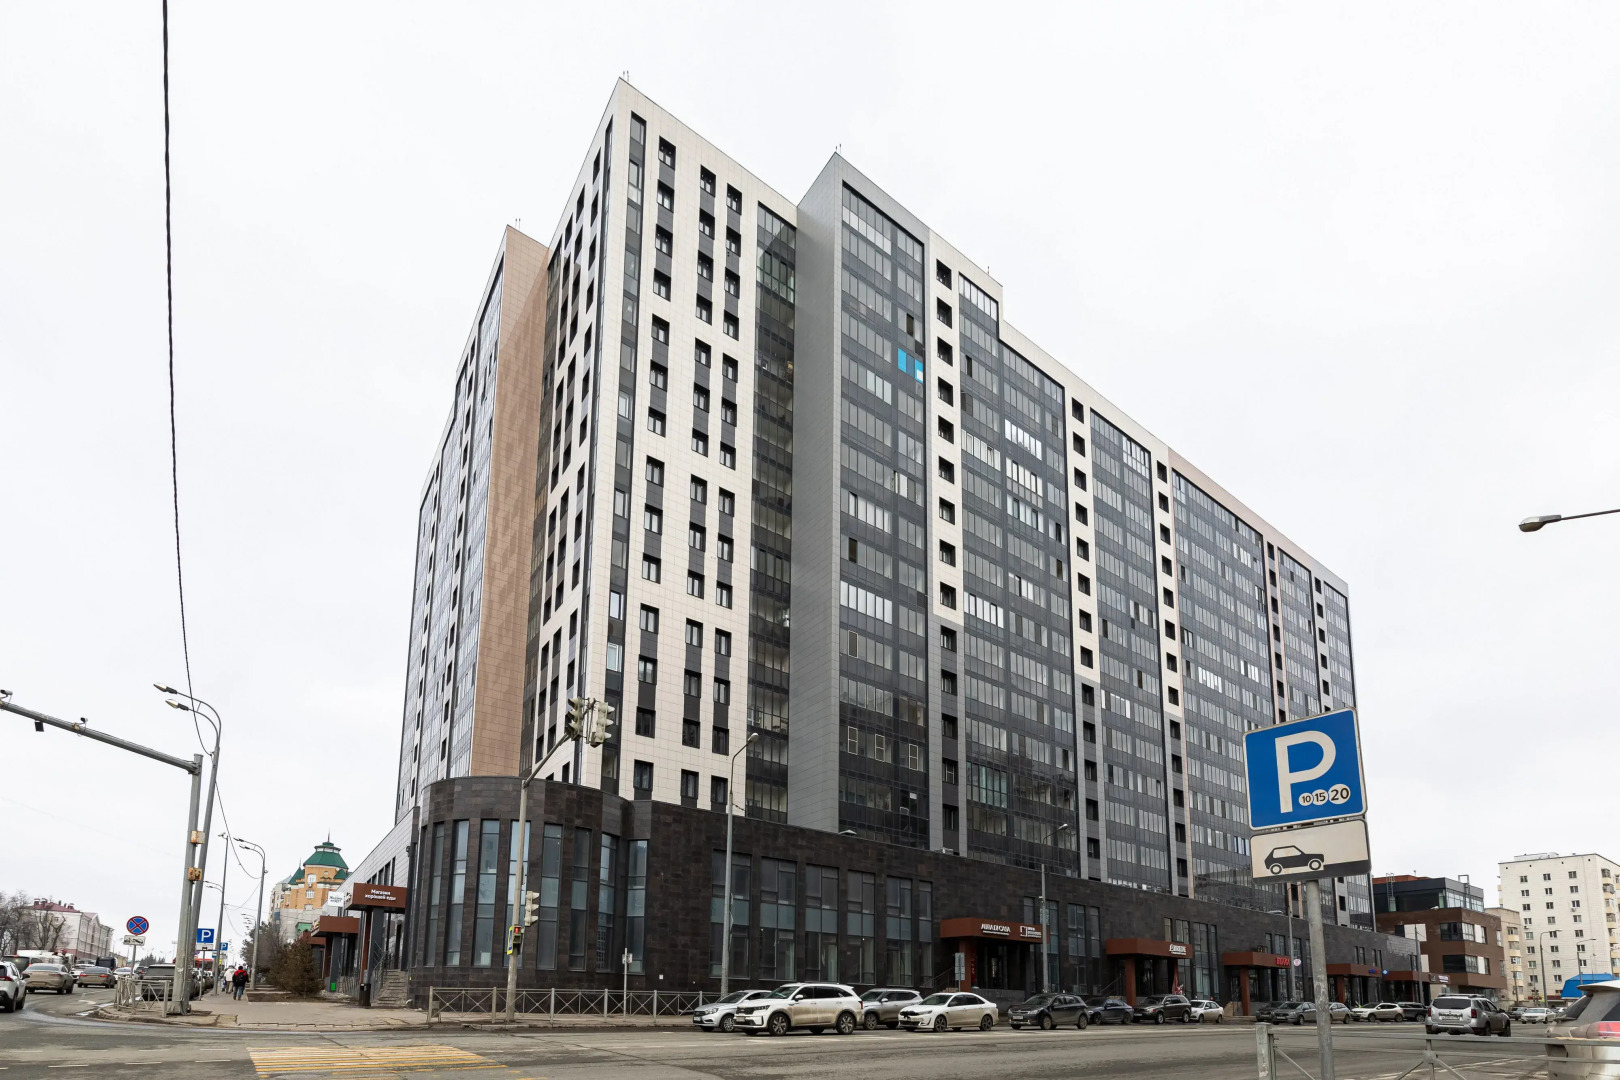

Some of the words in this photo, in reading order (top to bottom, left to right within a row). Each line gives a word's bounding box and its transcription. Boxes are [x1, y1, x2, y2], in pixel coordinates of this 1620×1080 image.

[1274, 730, 1336, 813] P
[1302, 795, 1311, 803] 10
[1314, 792, 1326, 802] 15
[1330, 788, 1349, 801] 20
[201, 930, 211, 942] P
